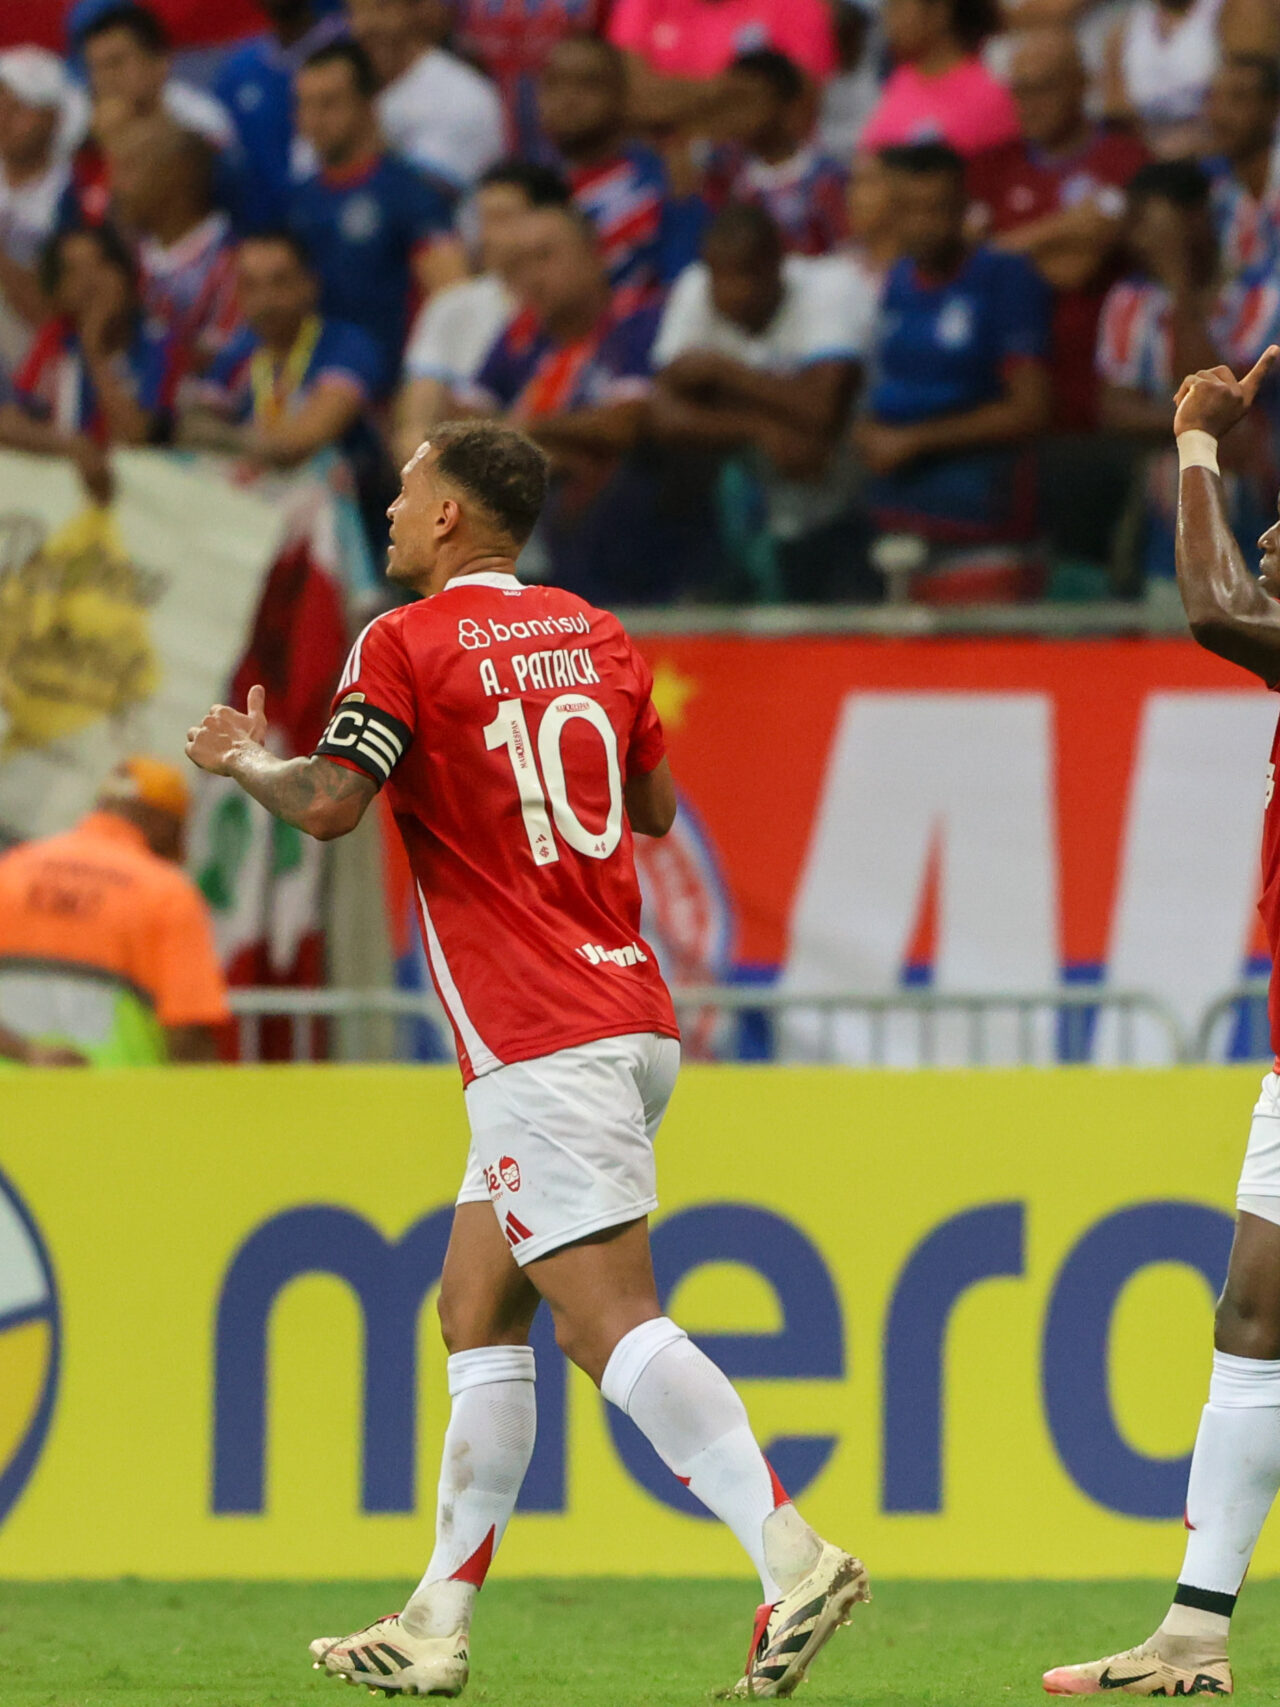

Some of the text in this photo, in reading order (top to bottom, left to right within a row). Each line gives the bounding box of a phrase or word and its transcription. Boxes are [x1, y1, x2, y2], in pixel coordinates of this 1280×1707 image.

[487, 611, 590, 642] banrisul
[480, 648, 600, 696] A. PATRICK
[483, 693, 623, 866] 10
